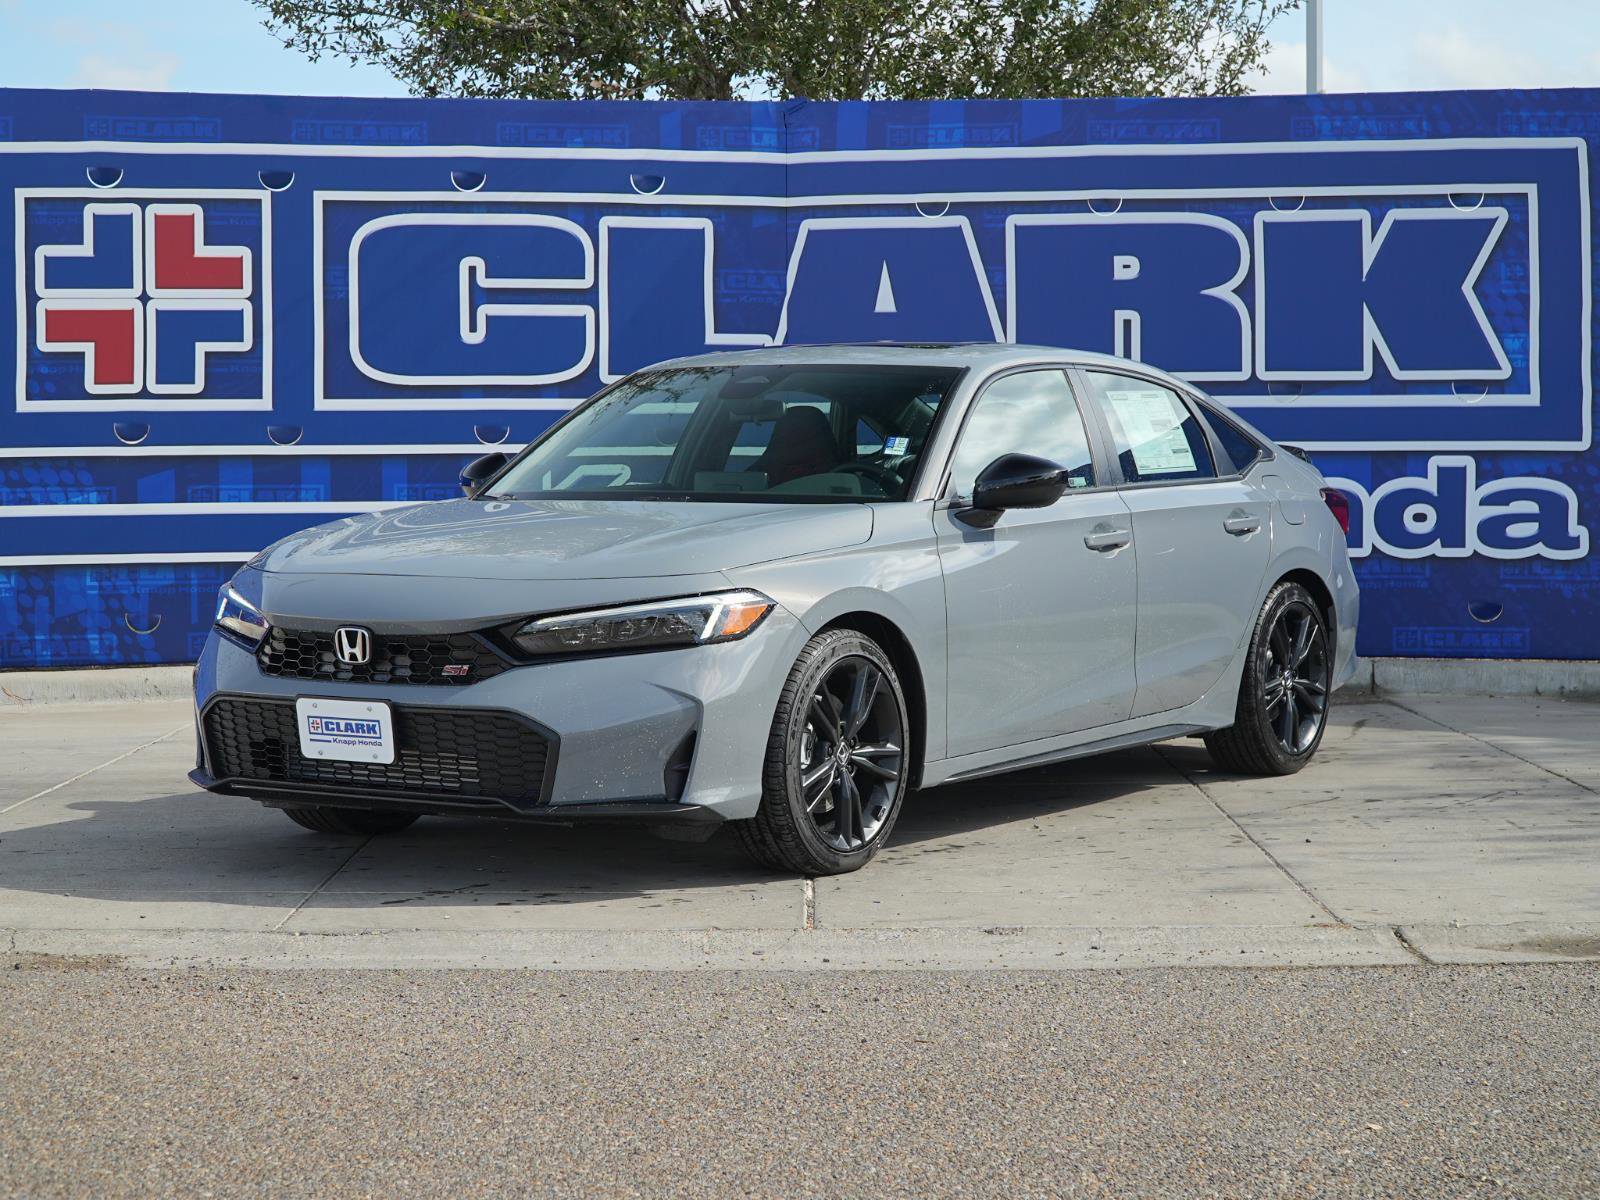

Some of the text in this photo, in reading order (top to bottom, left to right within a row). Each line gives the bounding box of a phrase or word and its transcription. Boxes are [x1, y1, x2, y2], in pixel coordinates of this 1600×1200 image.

[323, 126, 420, 142] CLARK
[348, 206, 1512, 387] CLARK
[441, 664, 470, 676] Si
[324, 720, 378, 735] CLARK
[332, 738, 382, 747] Knapp Honda
